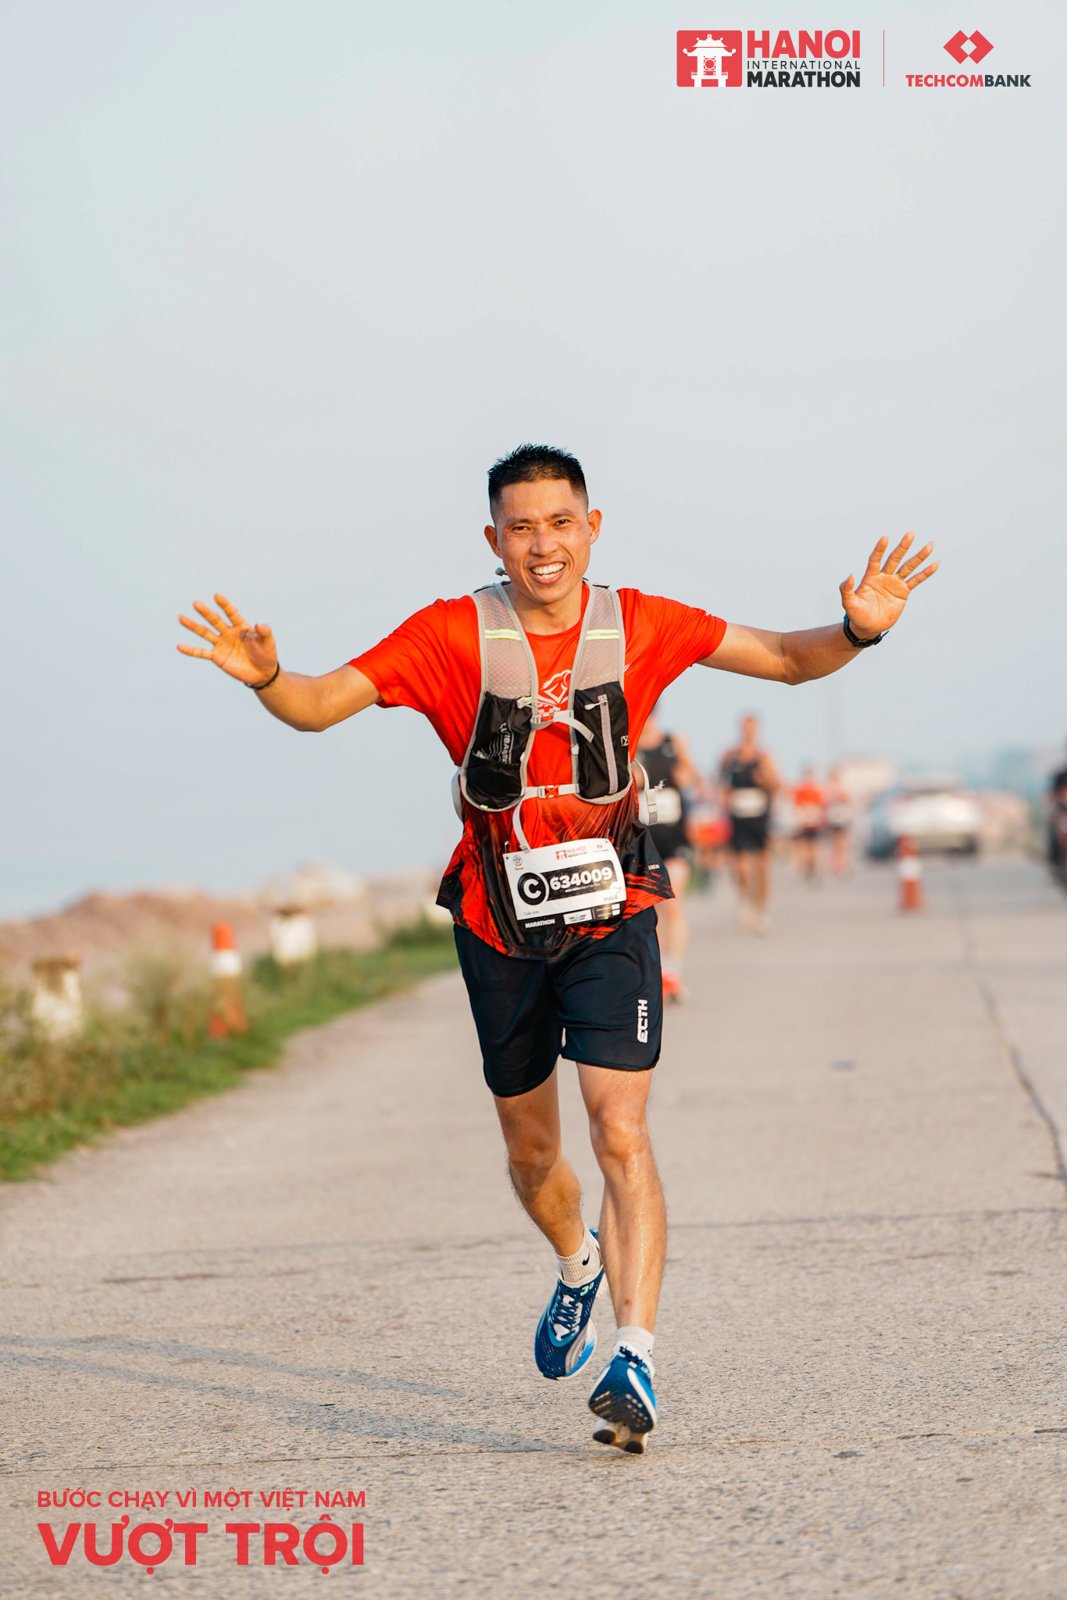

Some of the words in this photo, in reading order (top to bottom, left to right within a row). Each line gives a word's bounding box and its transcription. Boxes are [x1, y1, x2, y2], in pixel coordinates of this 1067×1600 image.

[523, 879, 542, 899] C
[549, 866, 613, 891] 634009
[525, 918, 556, 929] MARATHON
